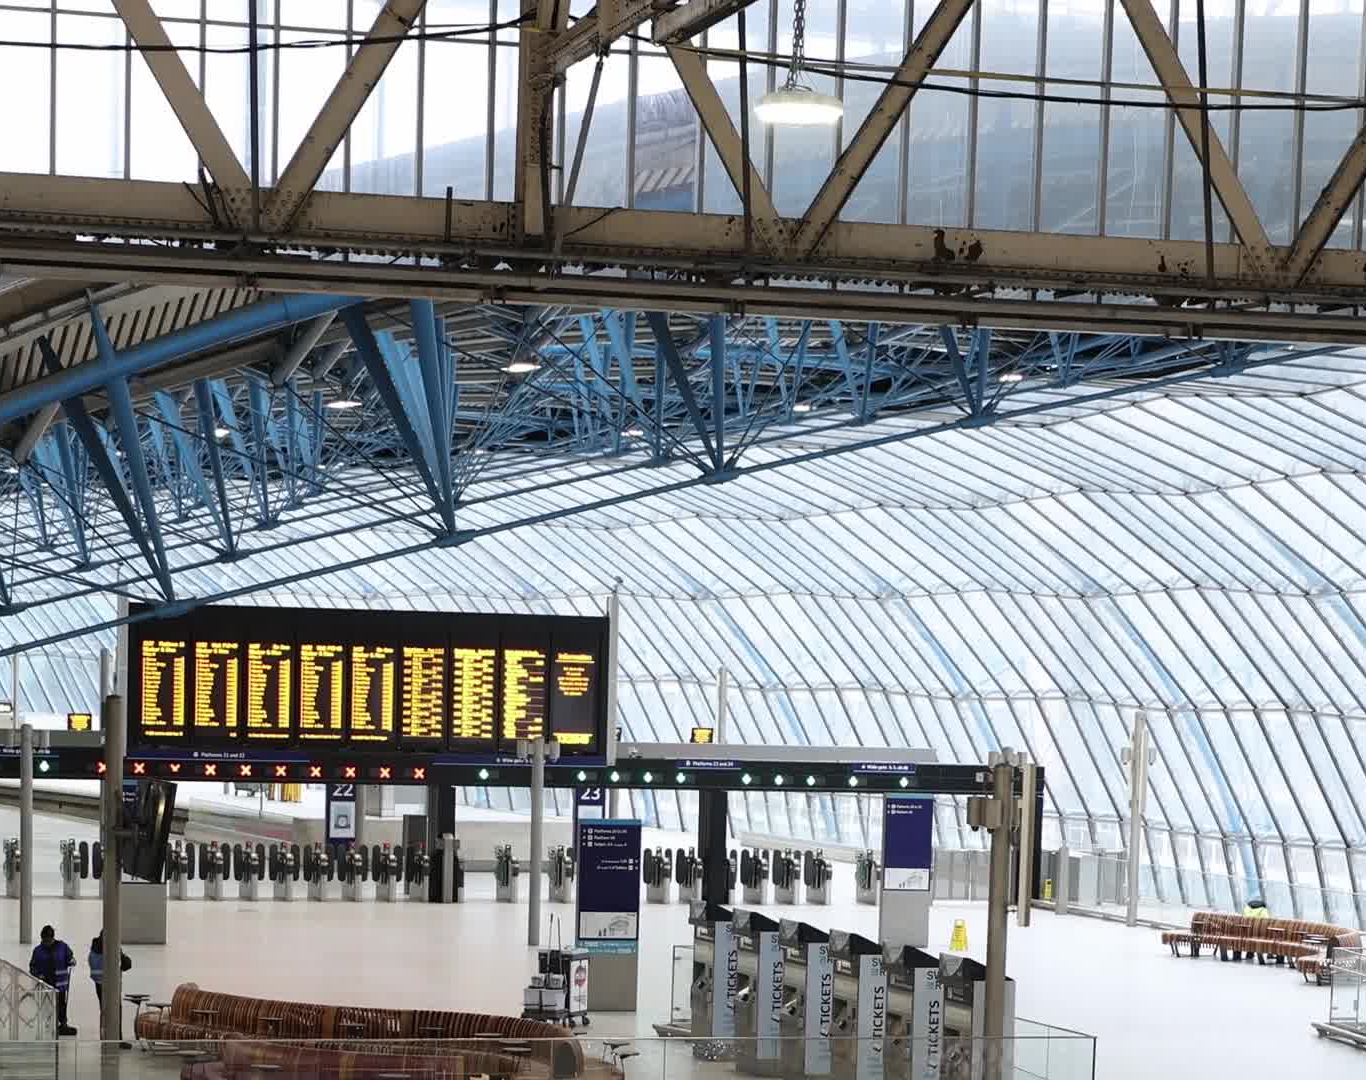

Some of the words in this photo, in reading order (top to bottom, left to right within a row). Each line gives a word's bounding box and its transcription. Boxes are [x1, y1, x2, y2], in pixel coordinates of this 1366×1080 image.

[332, 783, 354, 797] 22
[580, 787, 601, 801] 23
[726, 949, 738, 999] TICKETS
[771, 960, 784, 1012] TICKETS
[820, 973, 832, 1025] TICKETS
[872, 986, 885, 1040] TICKETS
[927, 1000, 940, 1057] TICKETS
